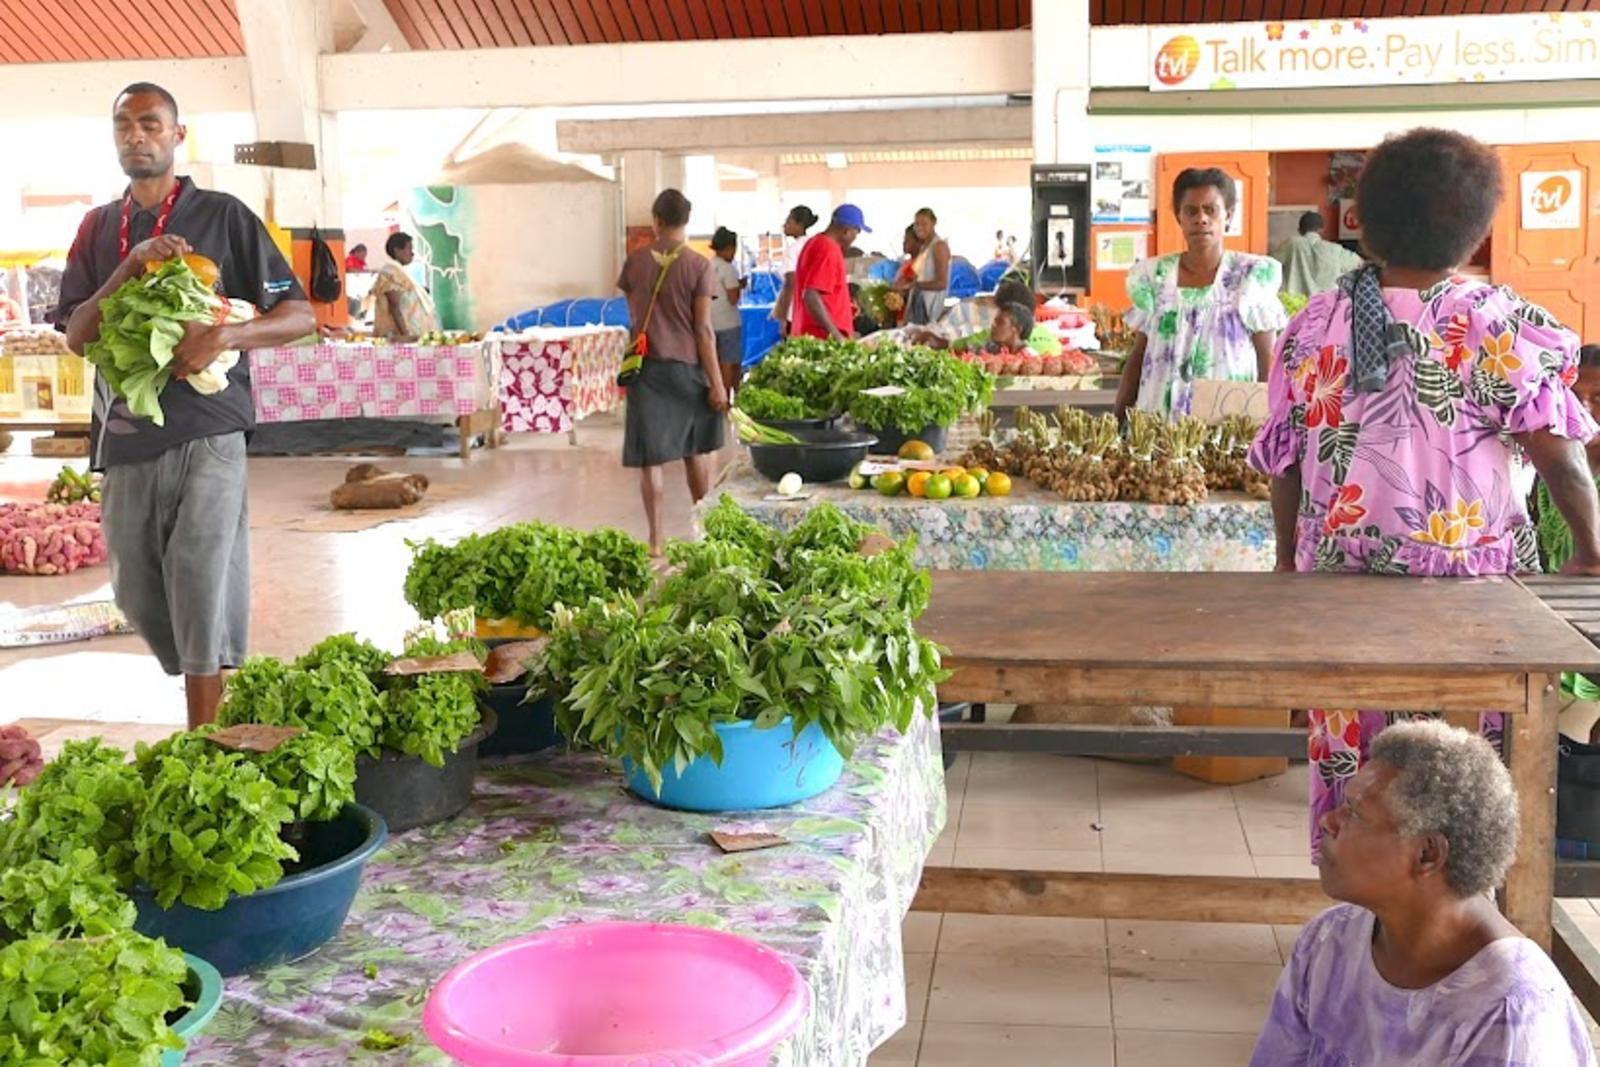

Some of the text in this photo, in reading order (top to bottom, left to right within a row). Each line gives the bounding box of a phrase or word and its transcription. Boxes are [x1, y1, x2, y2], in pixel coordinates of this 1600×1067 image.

[1157, 47, 1190, 78] tvl
[1205, 28, 1597, 78] Talk more. Pay less. Sim
[1532, 184, 1564, 210] tvl
